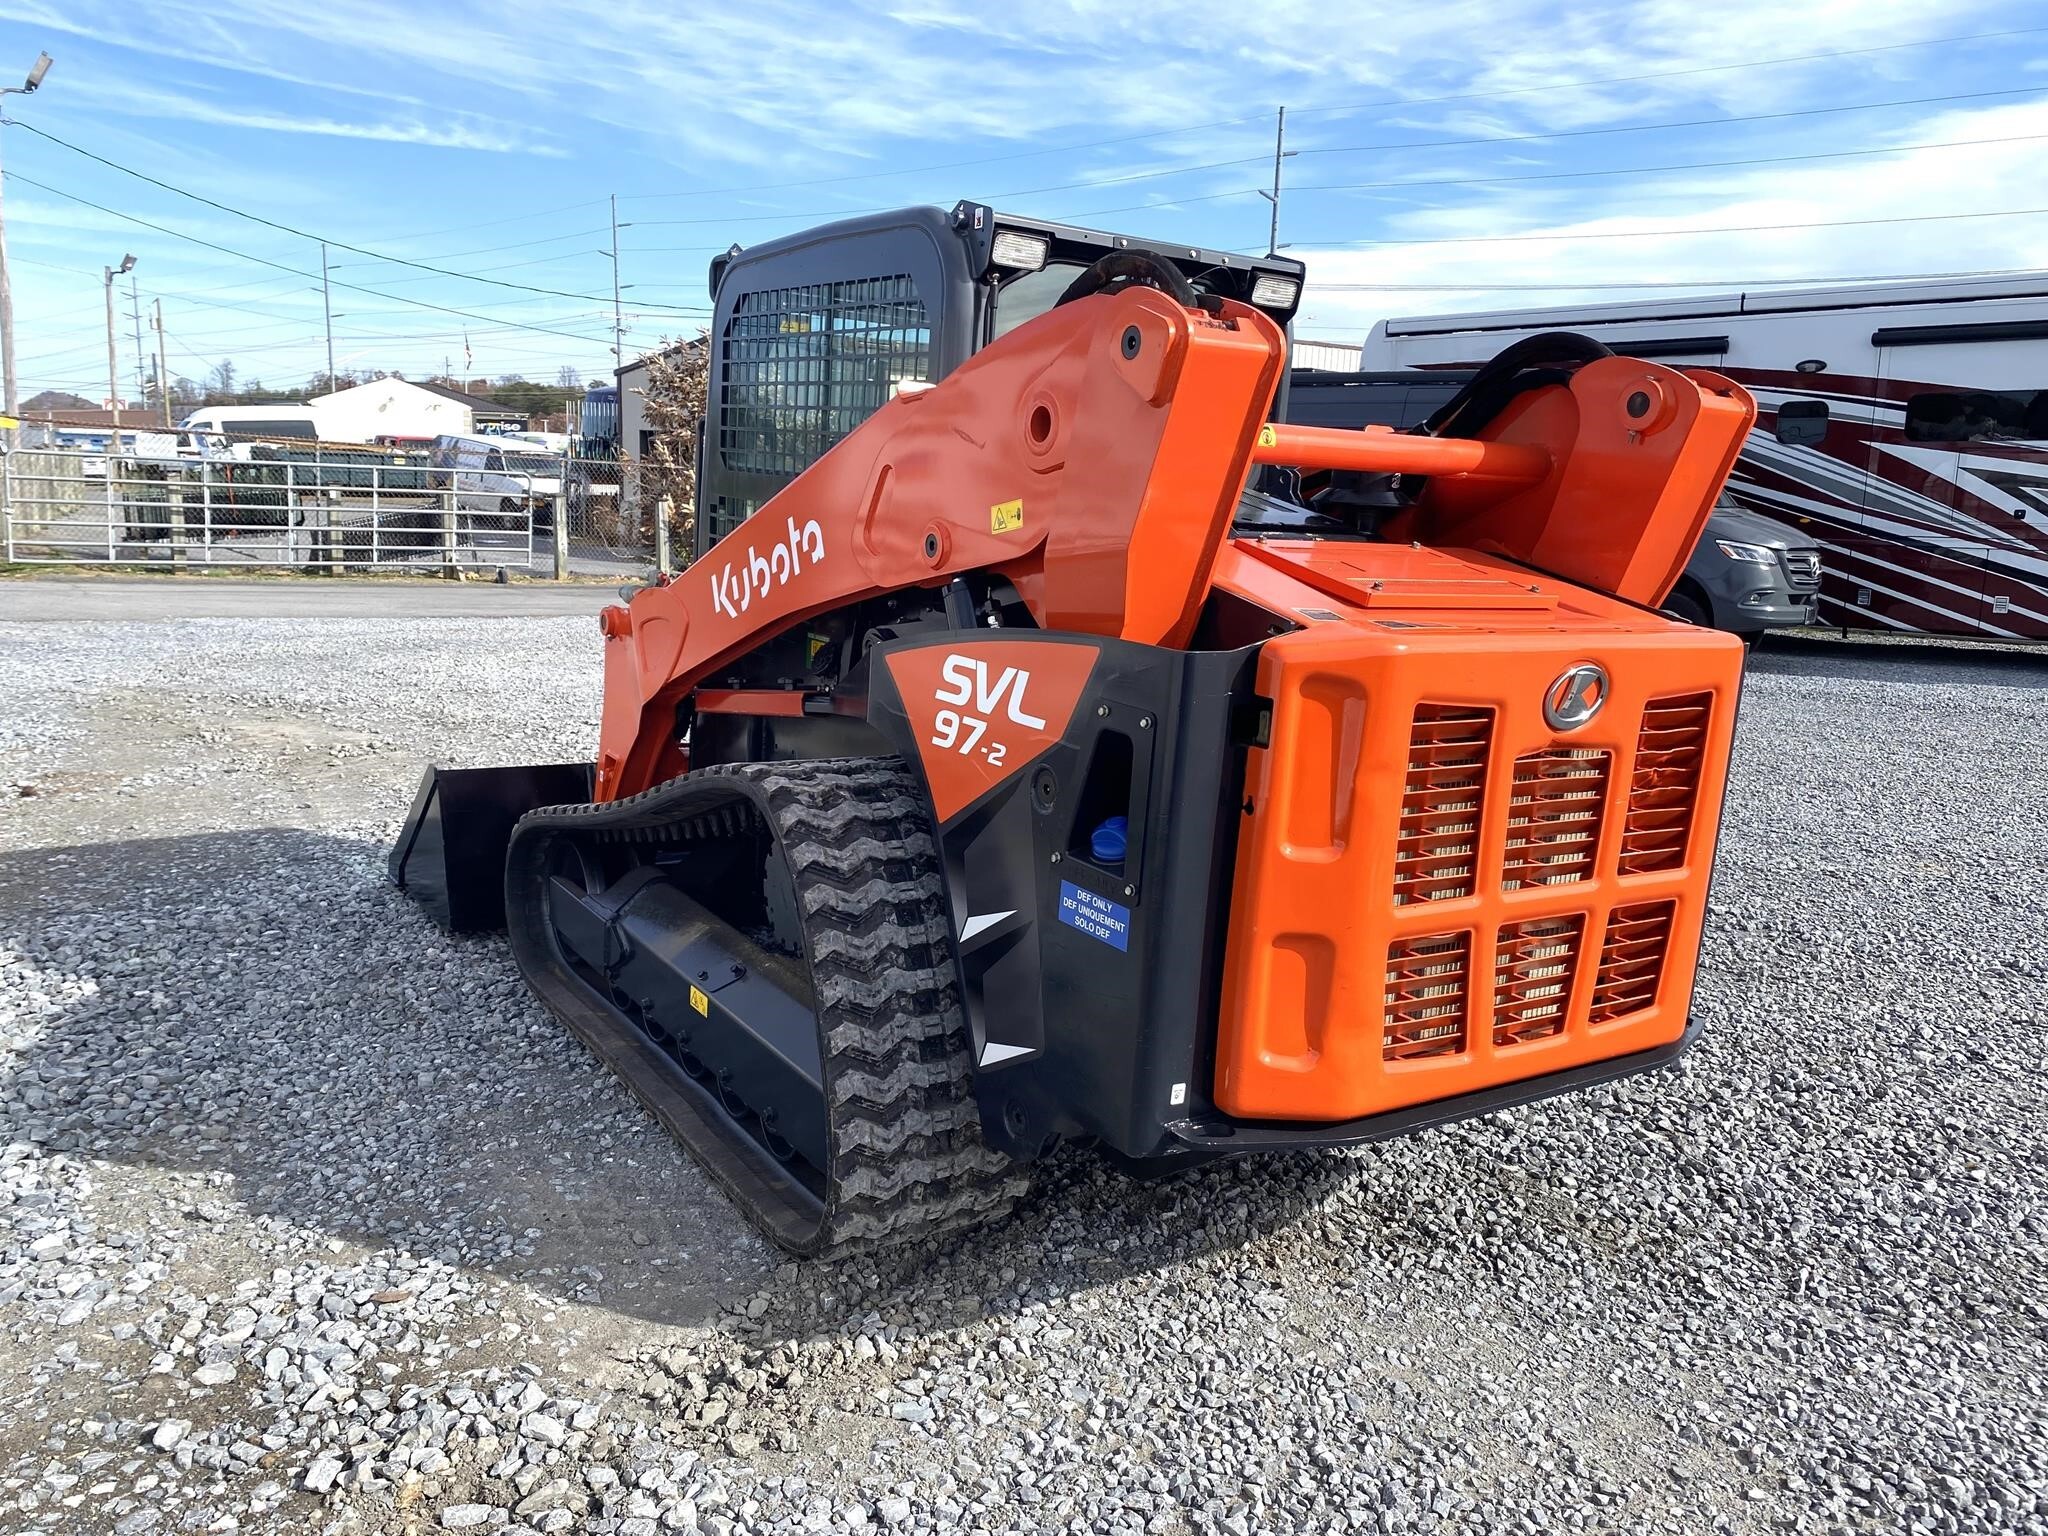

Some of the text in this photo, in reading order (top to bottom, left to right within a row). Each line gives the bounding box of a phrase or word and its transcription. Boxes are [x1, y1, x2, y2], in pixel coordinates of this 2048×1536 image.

[711, 516, 825, 619] Kubota
[935, 654, 1046, 731] SVL
[1063, 897, 1125, 933] DEF UNIQUEMENT
[1077, 889, 1112, 913] DEF ONLY
[1074, 915, 1110, 939] SOLO DEF
